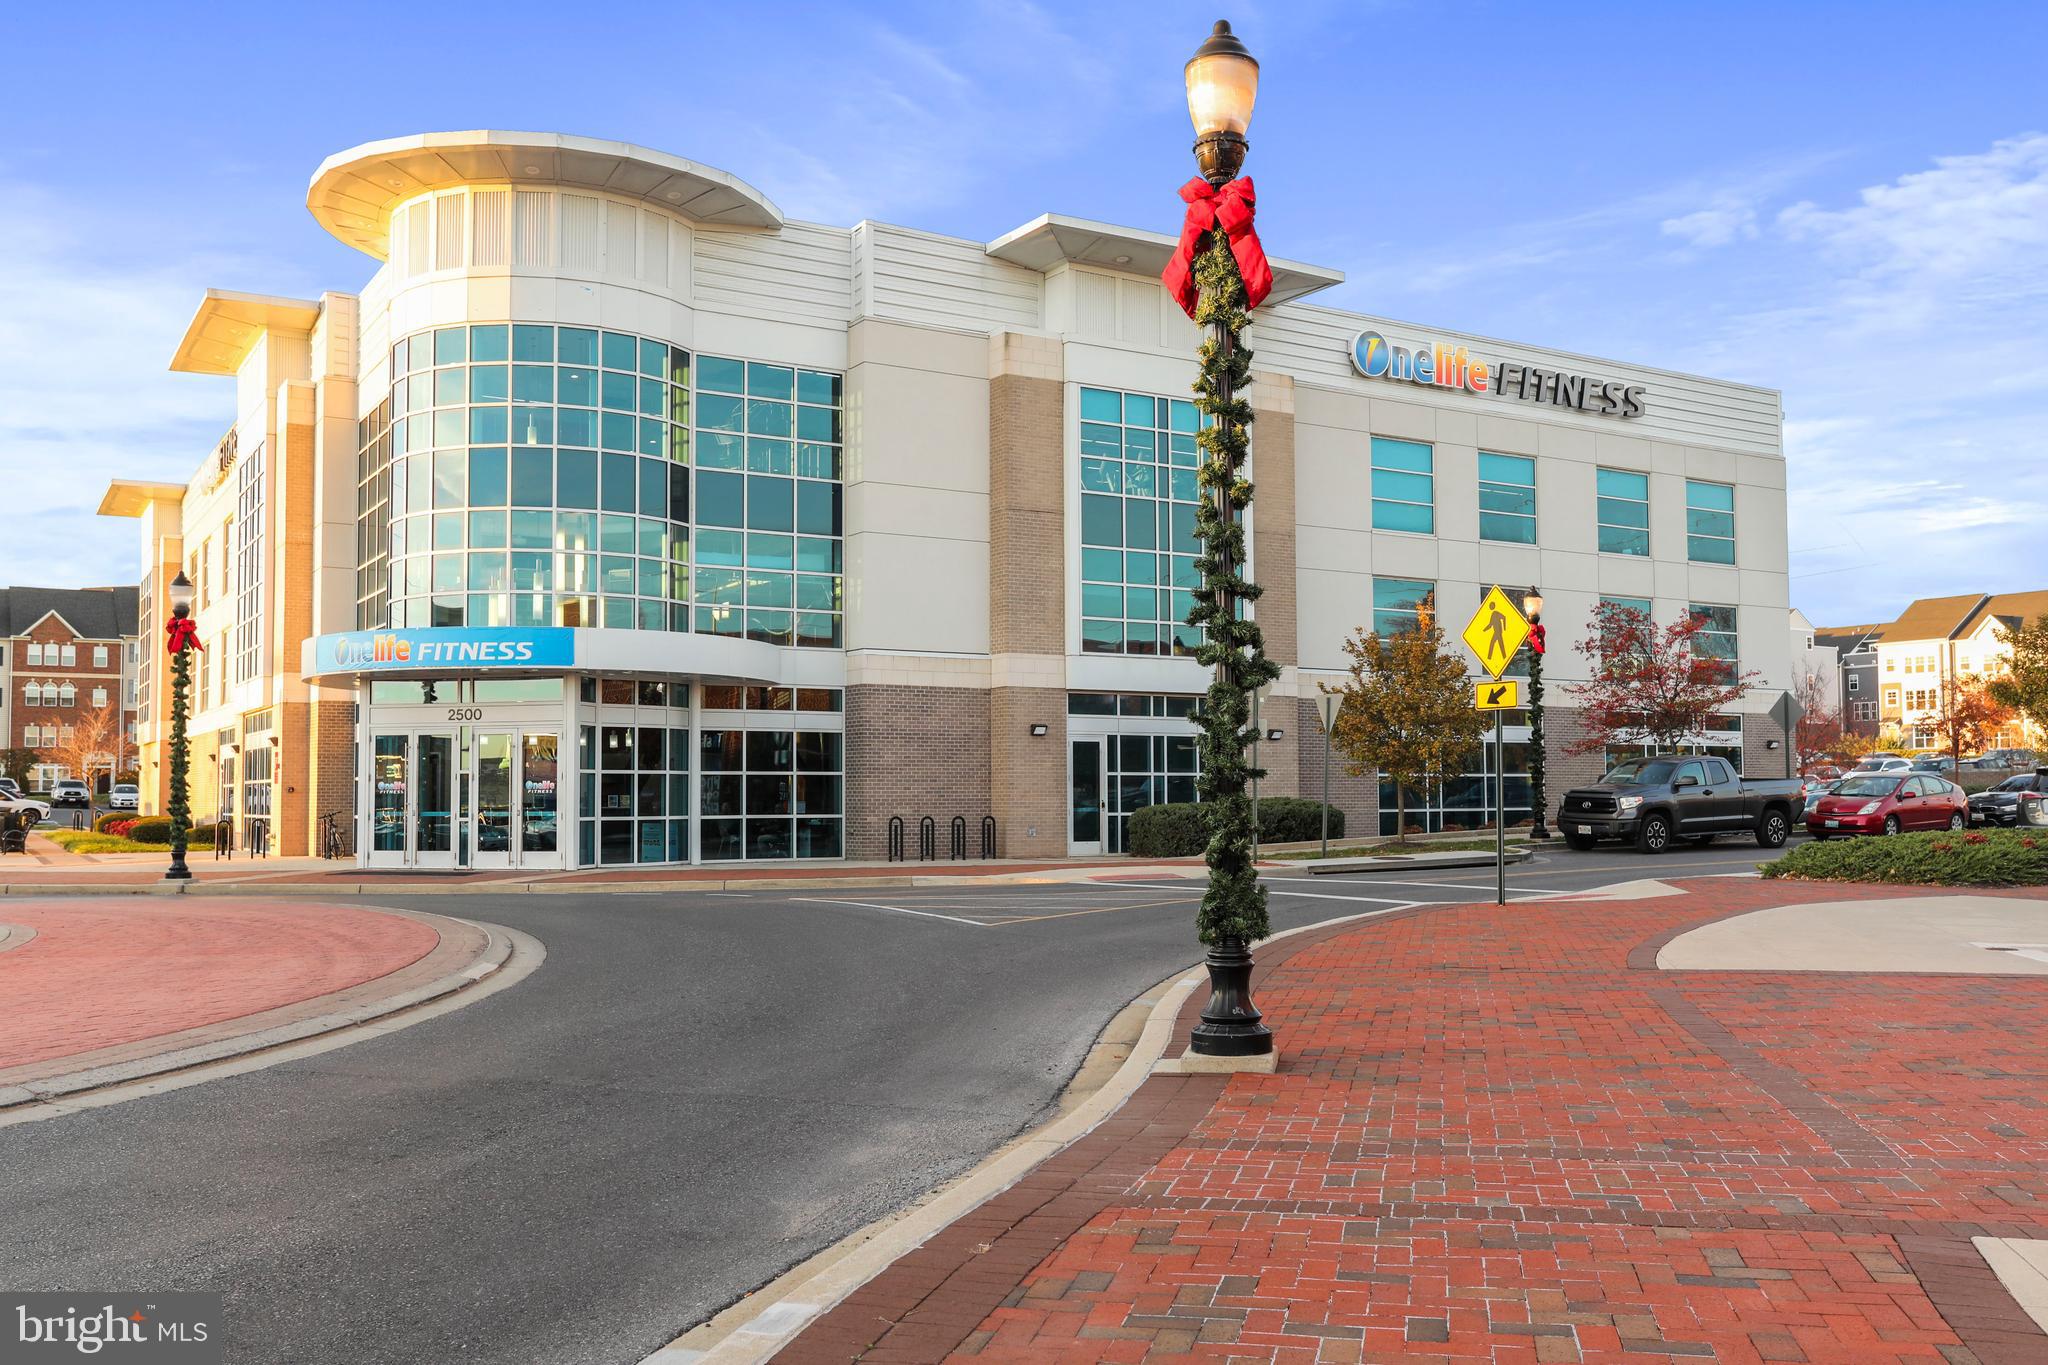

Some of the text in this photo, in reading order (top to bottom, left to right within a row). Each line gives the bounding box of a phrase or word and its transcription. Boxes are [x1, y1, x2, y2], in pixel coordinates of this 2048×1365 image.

[1352, 329, 1647, 418] Onelife FITNESS
[335, 634, 534, 665] Onelife FITNESS
[448, 708, 482, 721] 2500
